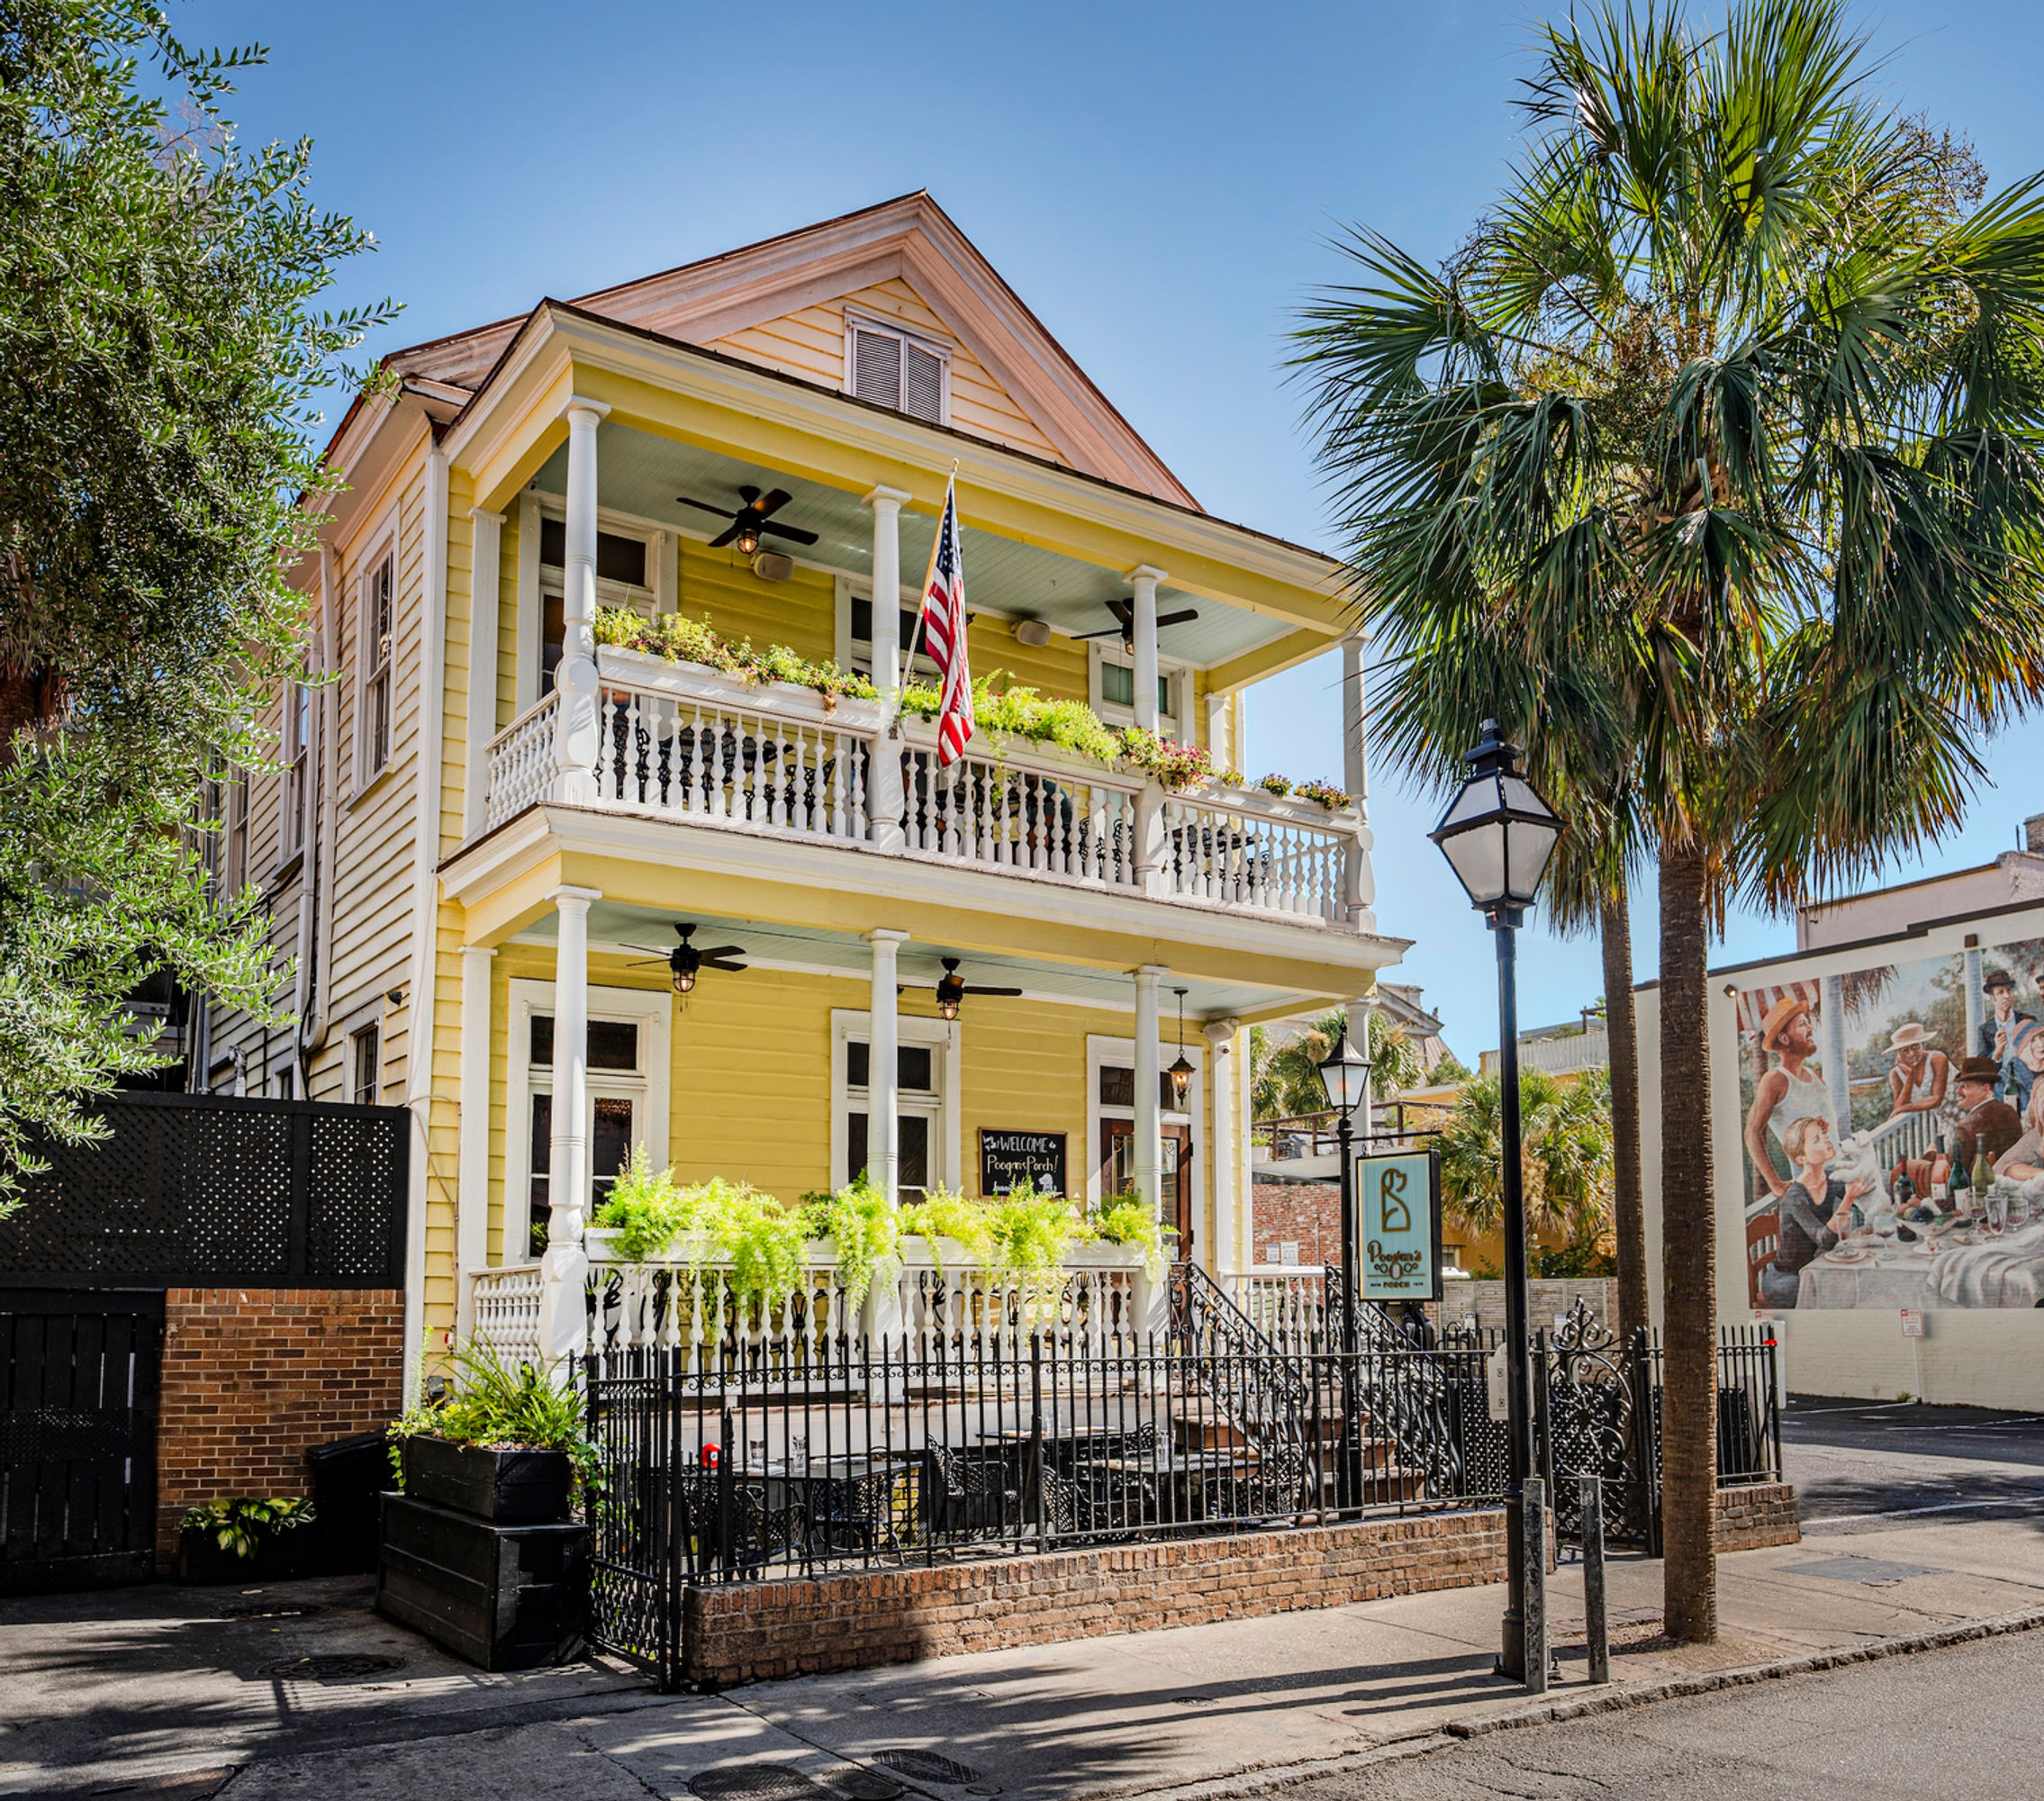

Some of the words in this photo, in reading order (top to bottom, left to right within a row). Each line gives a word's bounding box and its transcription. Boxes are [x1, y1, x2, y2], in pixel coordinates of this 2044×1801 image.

[1000, 1136, 1047, 1153] WELCOME
[1027, 1154, 1059, 1173] Porch!
[1367, 1239, 1423, 1280] Poogan's
